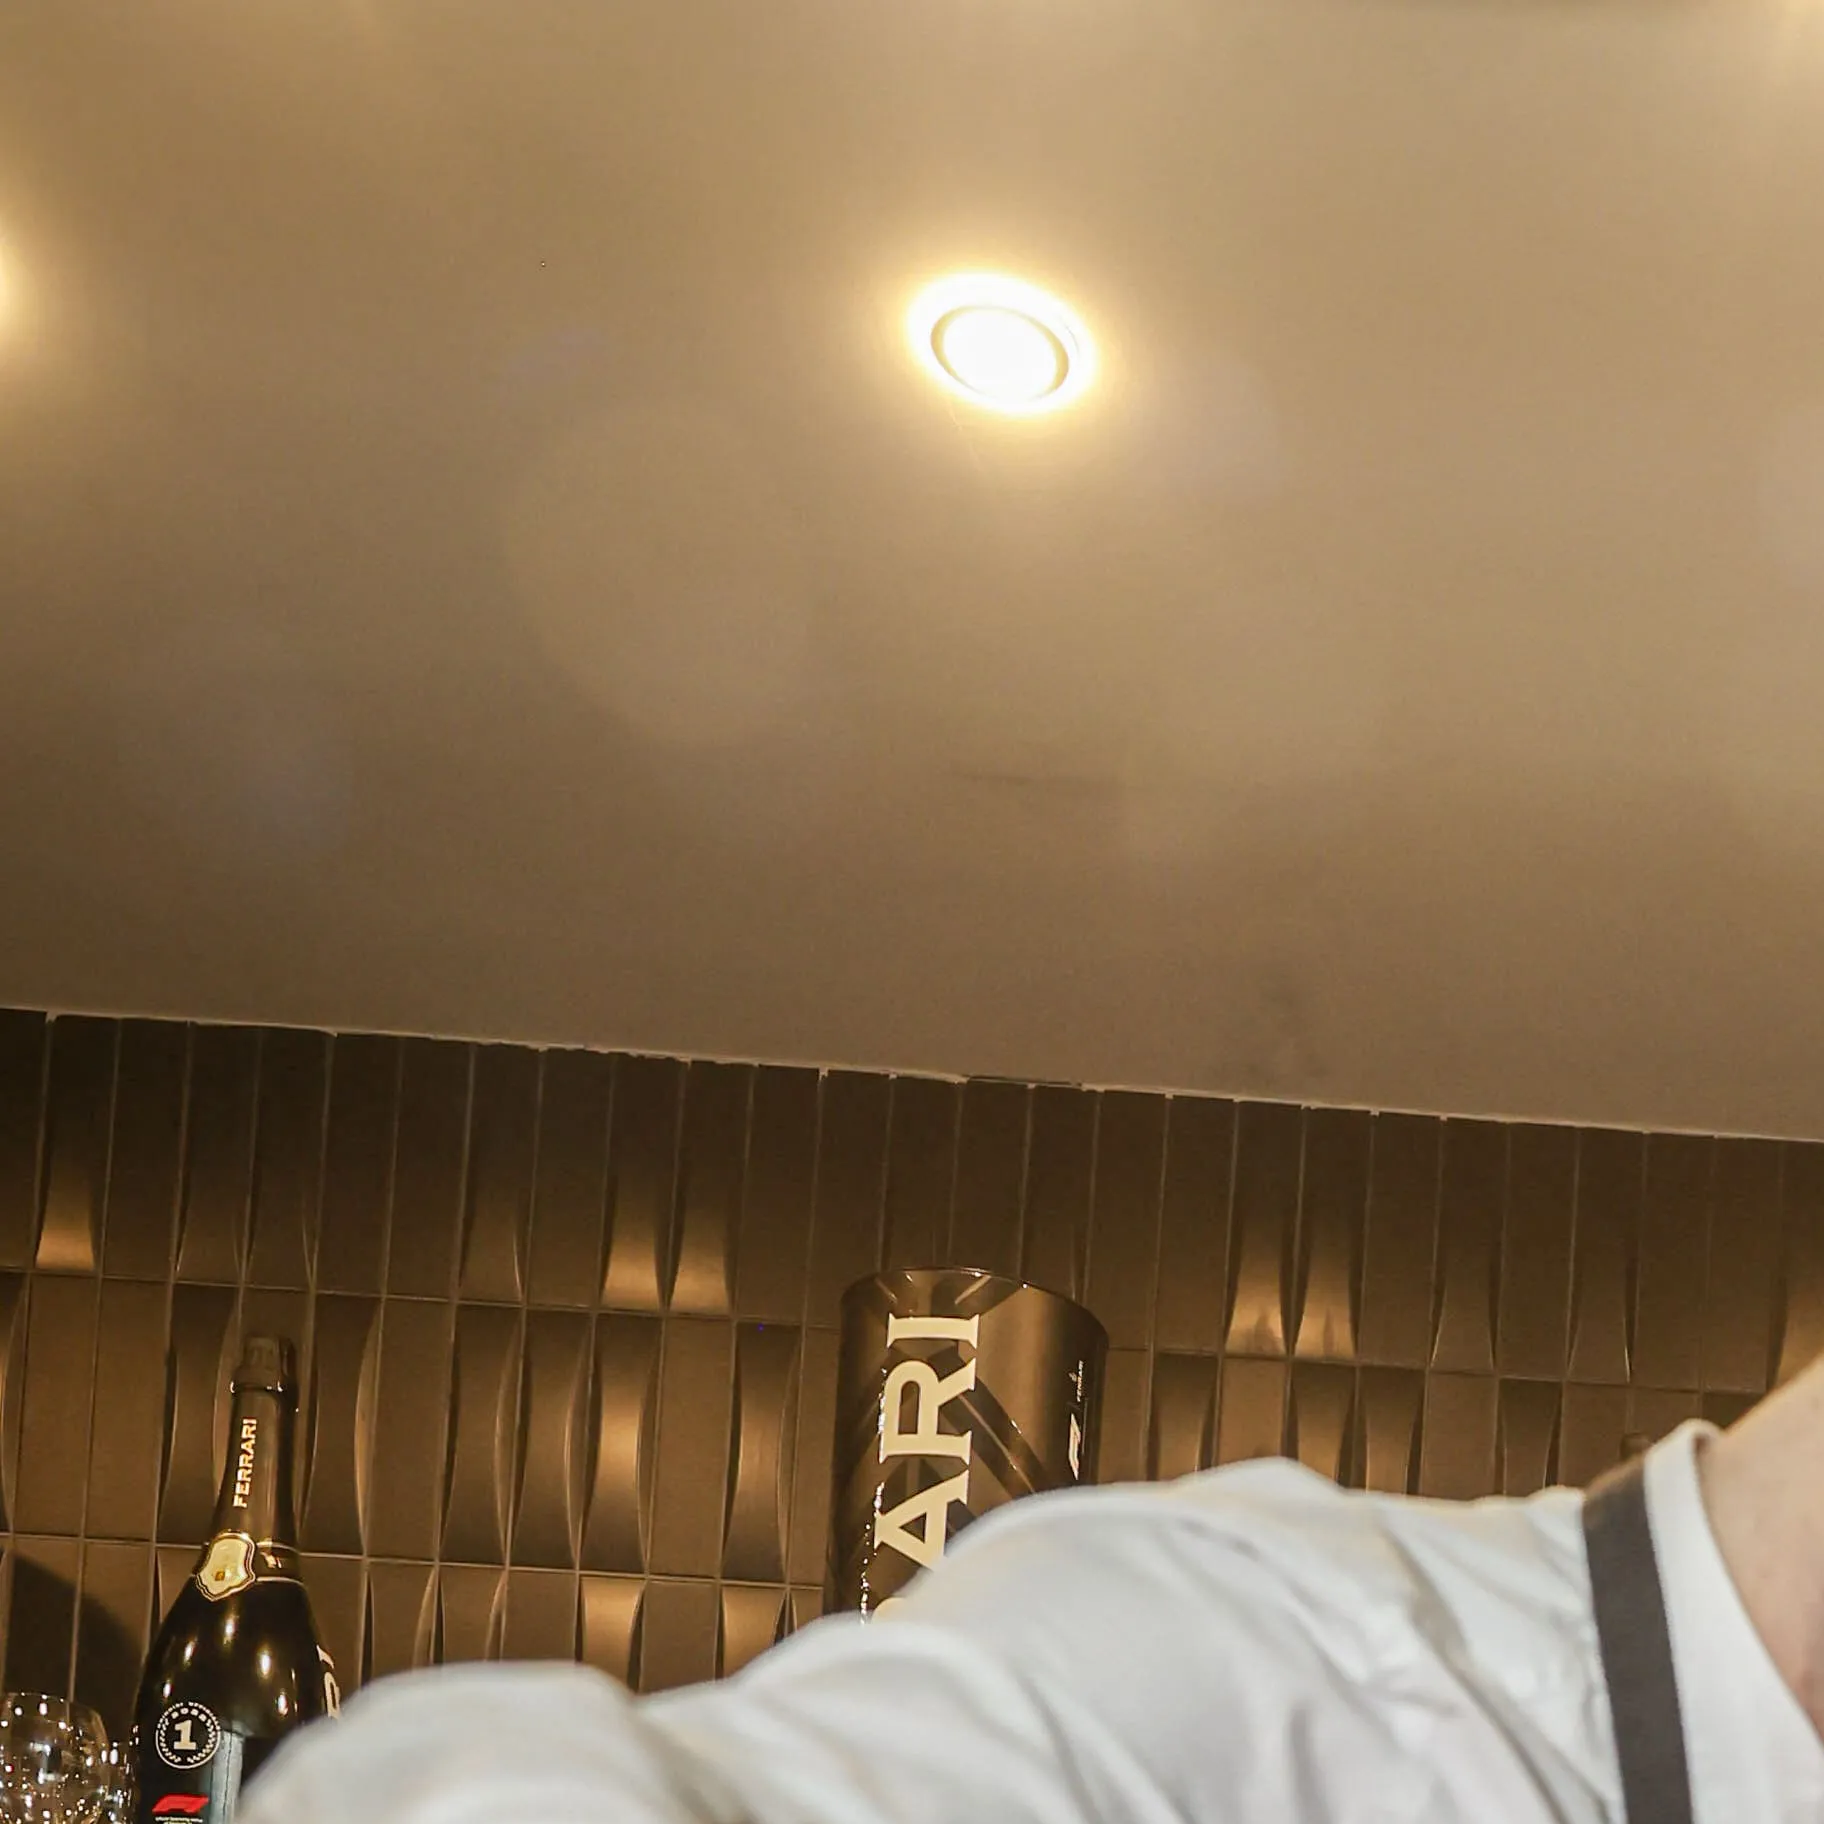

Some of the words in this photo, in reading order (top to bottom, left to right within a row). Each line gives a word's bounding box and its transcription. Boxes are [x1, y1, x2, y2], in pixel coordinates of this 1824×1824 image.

[232, 1418, 257, 1508] FERRARI
[874, 1312, 980, 1622] ARI
[173, 1719, 197, 1750] 1
